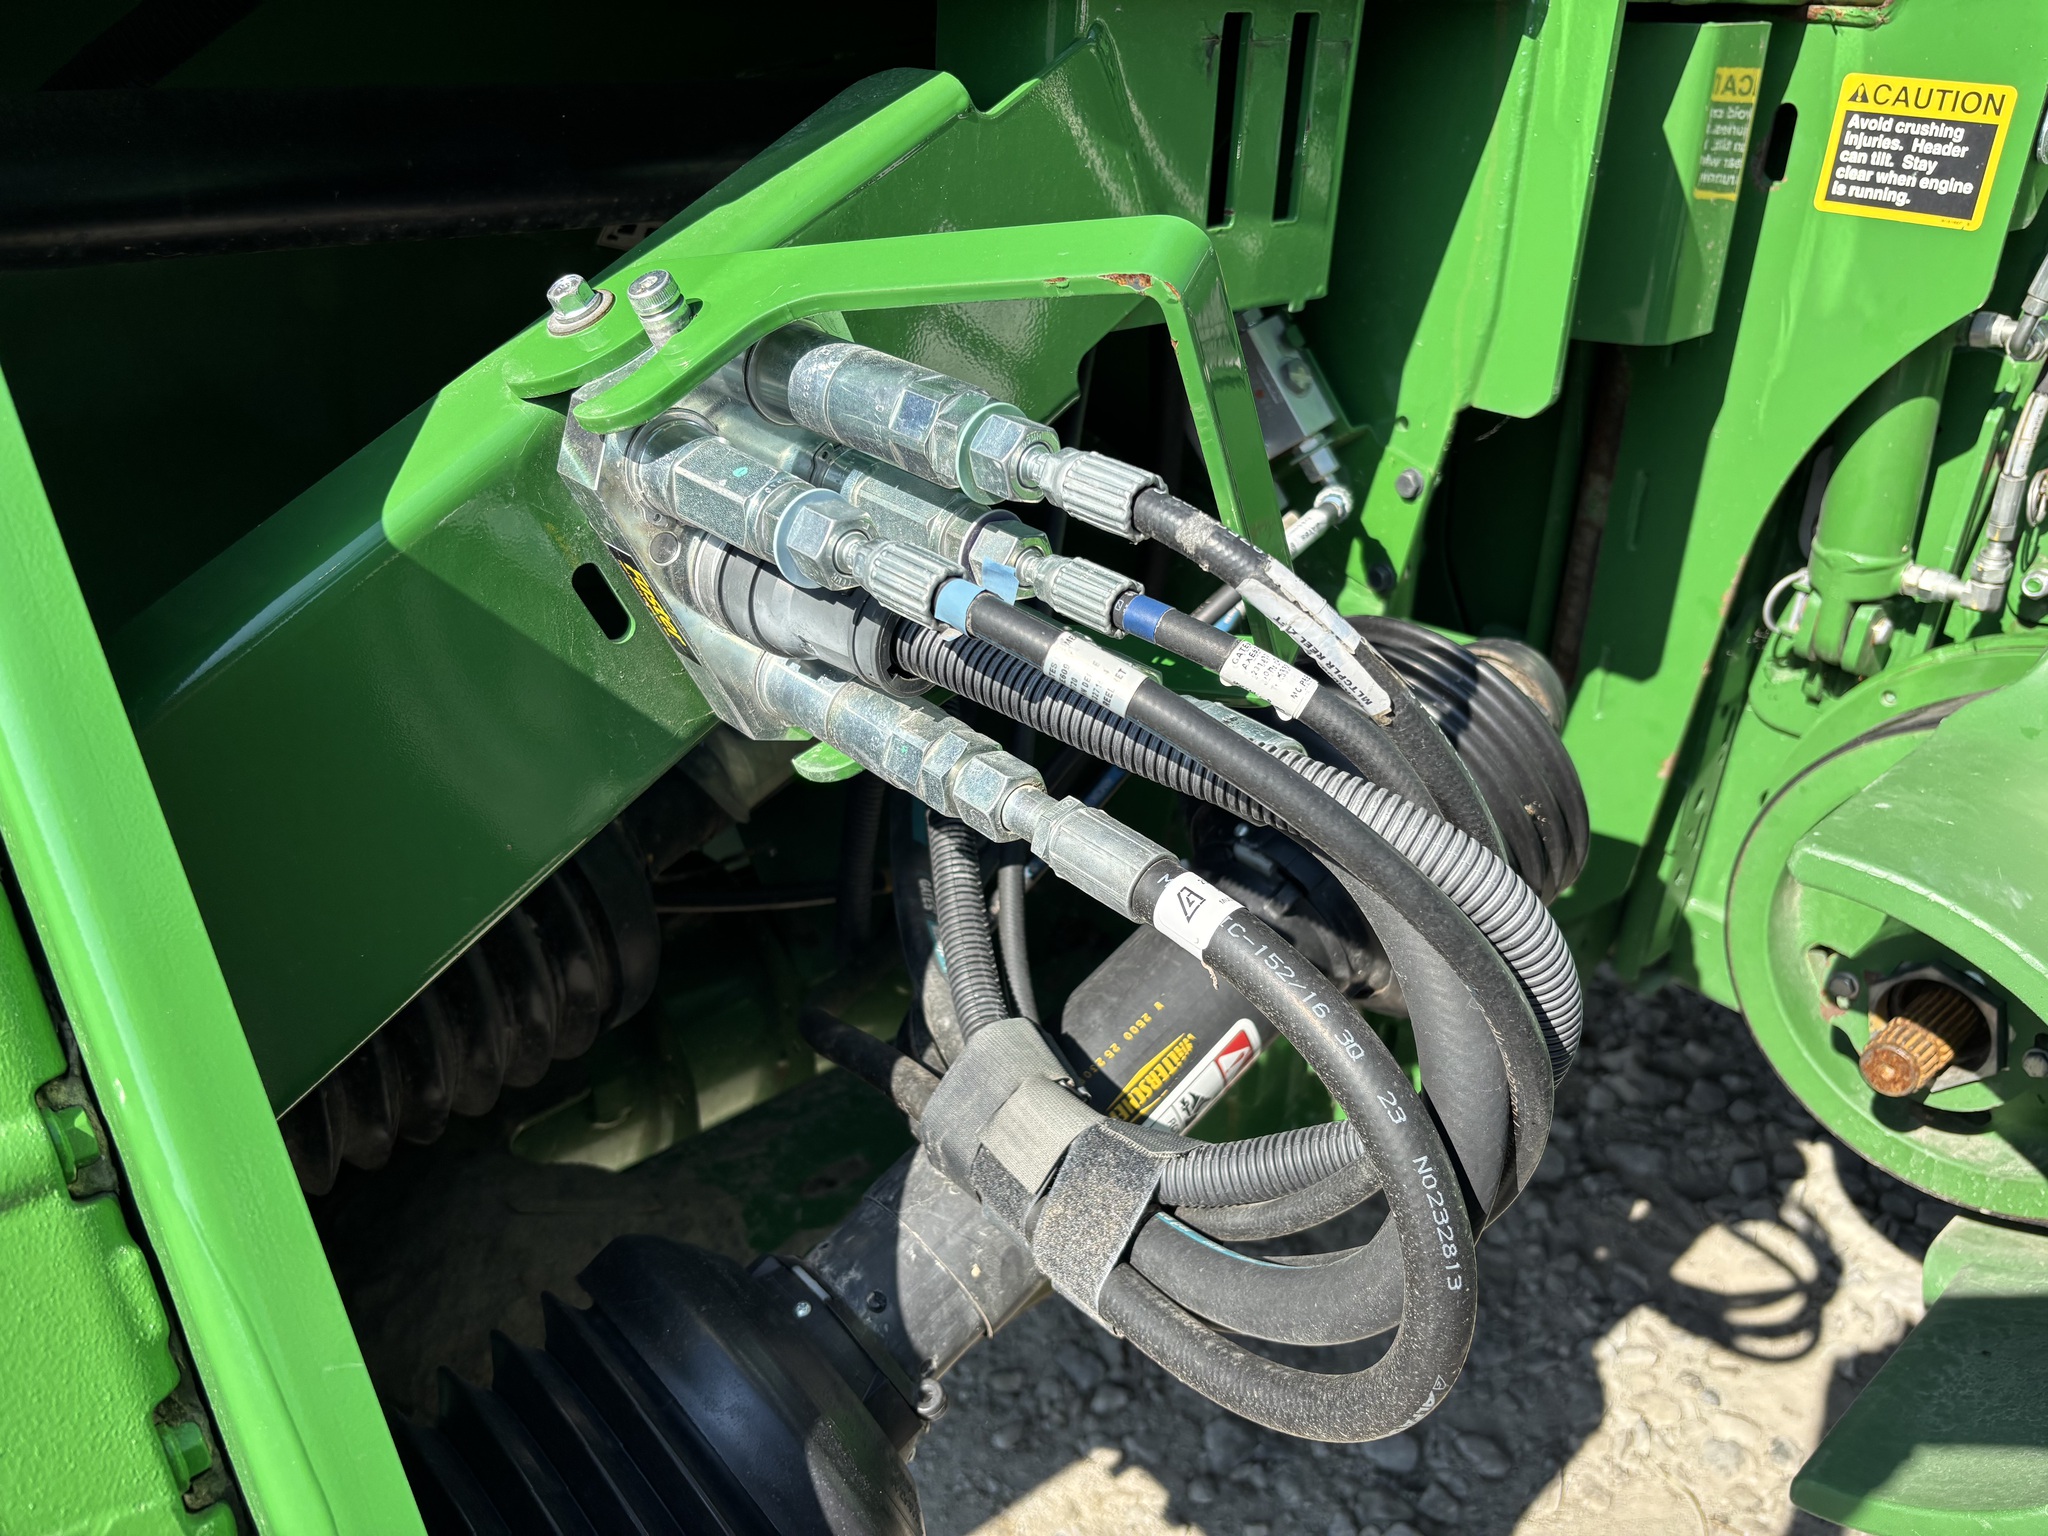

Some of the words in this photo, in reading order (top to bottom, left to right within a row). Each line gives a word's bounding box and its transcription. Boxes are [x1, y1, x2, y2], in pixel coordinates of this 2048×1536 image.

[1873, 84, 2006, 116] CAUTION
[1847, 114, 1894, 132] Avoid
[1894, 121, 1966, 143] crushing
[1843, 130, 1904, 151] injuries.
[1911, 137, 1969, 158] Header
[1839, 150, 1868, 164] can
[1870, 151, 1894, 167] tilt.
[1901, 154, 1938, 175] Stay
[1831, 180, 1847, 196] is
[1848, 184, 1911, 207] running.
[1835, 165, 1874, 182] clear
[1876, 170, 1918, 188] when
[1919, 176, 1974, 195] engine
[1300, 635, 1327, 660] REEL
[1376, 1090, 1407, 1125] 23
